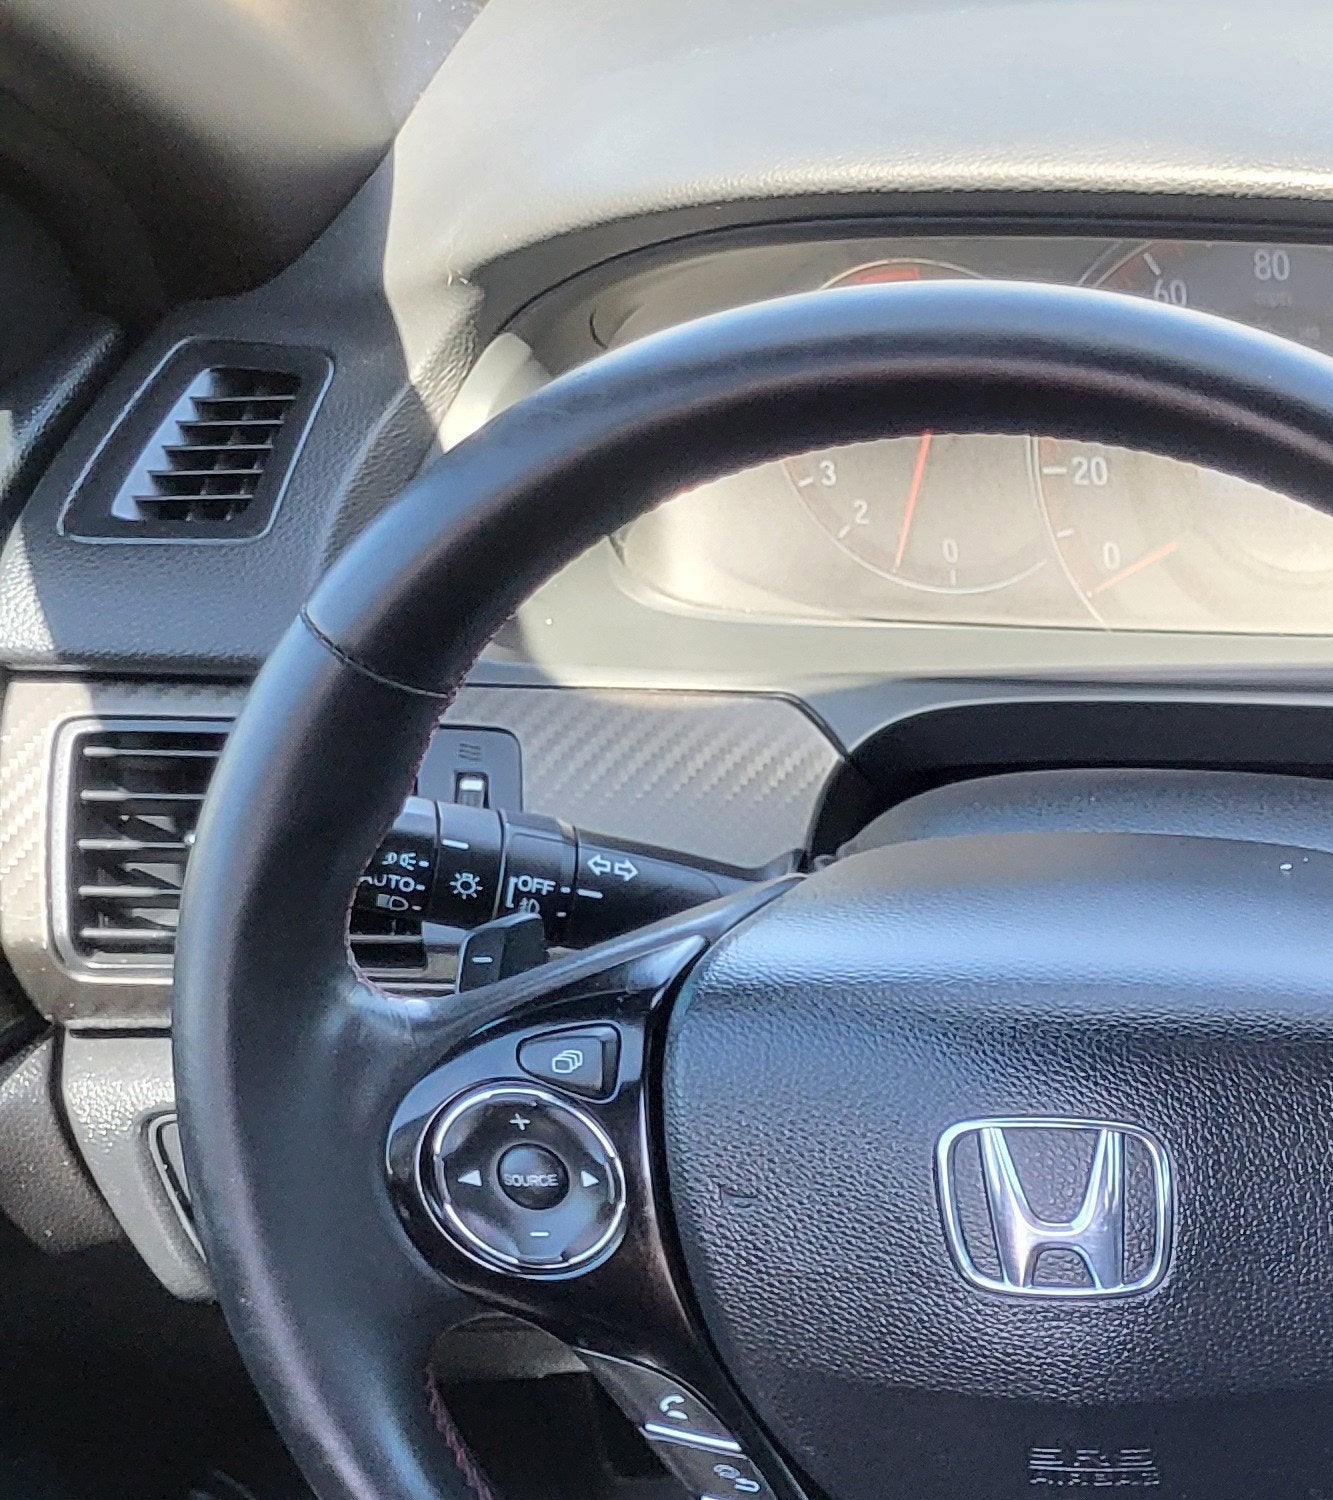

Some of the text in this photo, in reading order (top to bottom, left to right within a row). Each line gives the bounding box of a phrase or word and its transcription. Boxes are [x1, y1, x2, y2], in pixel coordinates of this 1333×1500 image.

[1253, 247, 1291, 281] 80
[820, 460, 837, 487] 3
[1073, 456, 1108, 485] 20
[854, 500, 869, 524] 2
[941, 538, 959, 564] 0
[1103, 541, 1121, 570] 0
[517, 874, 557, 896] OFF
[502, 1173, 559, 1188] SOURCE
